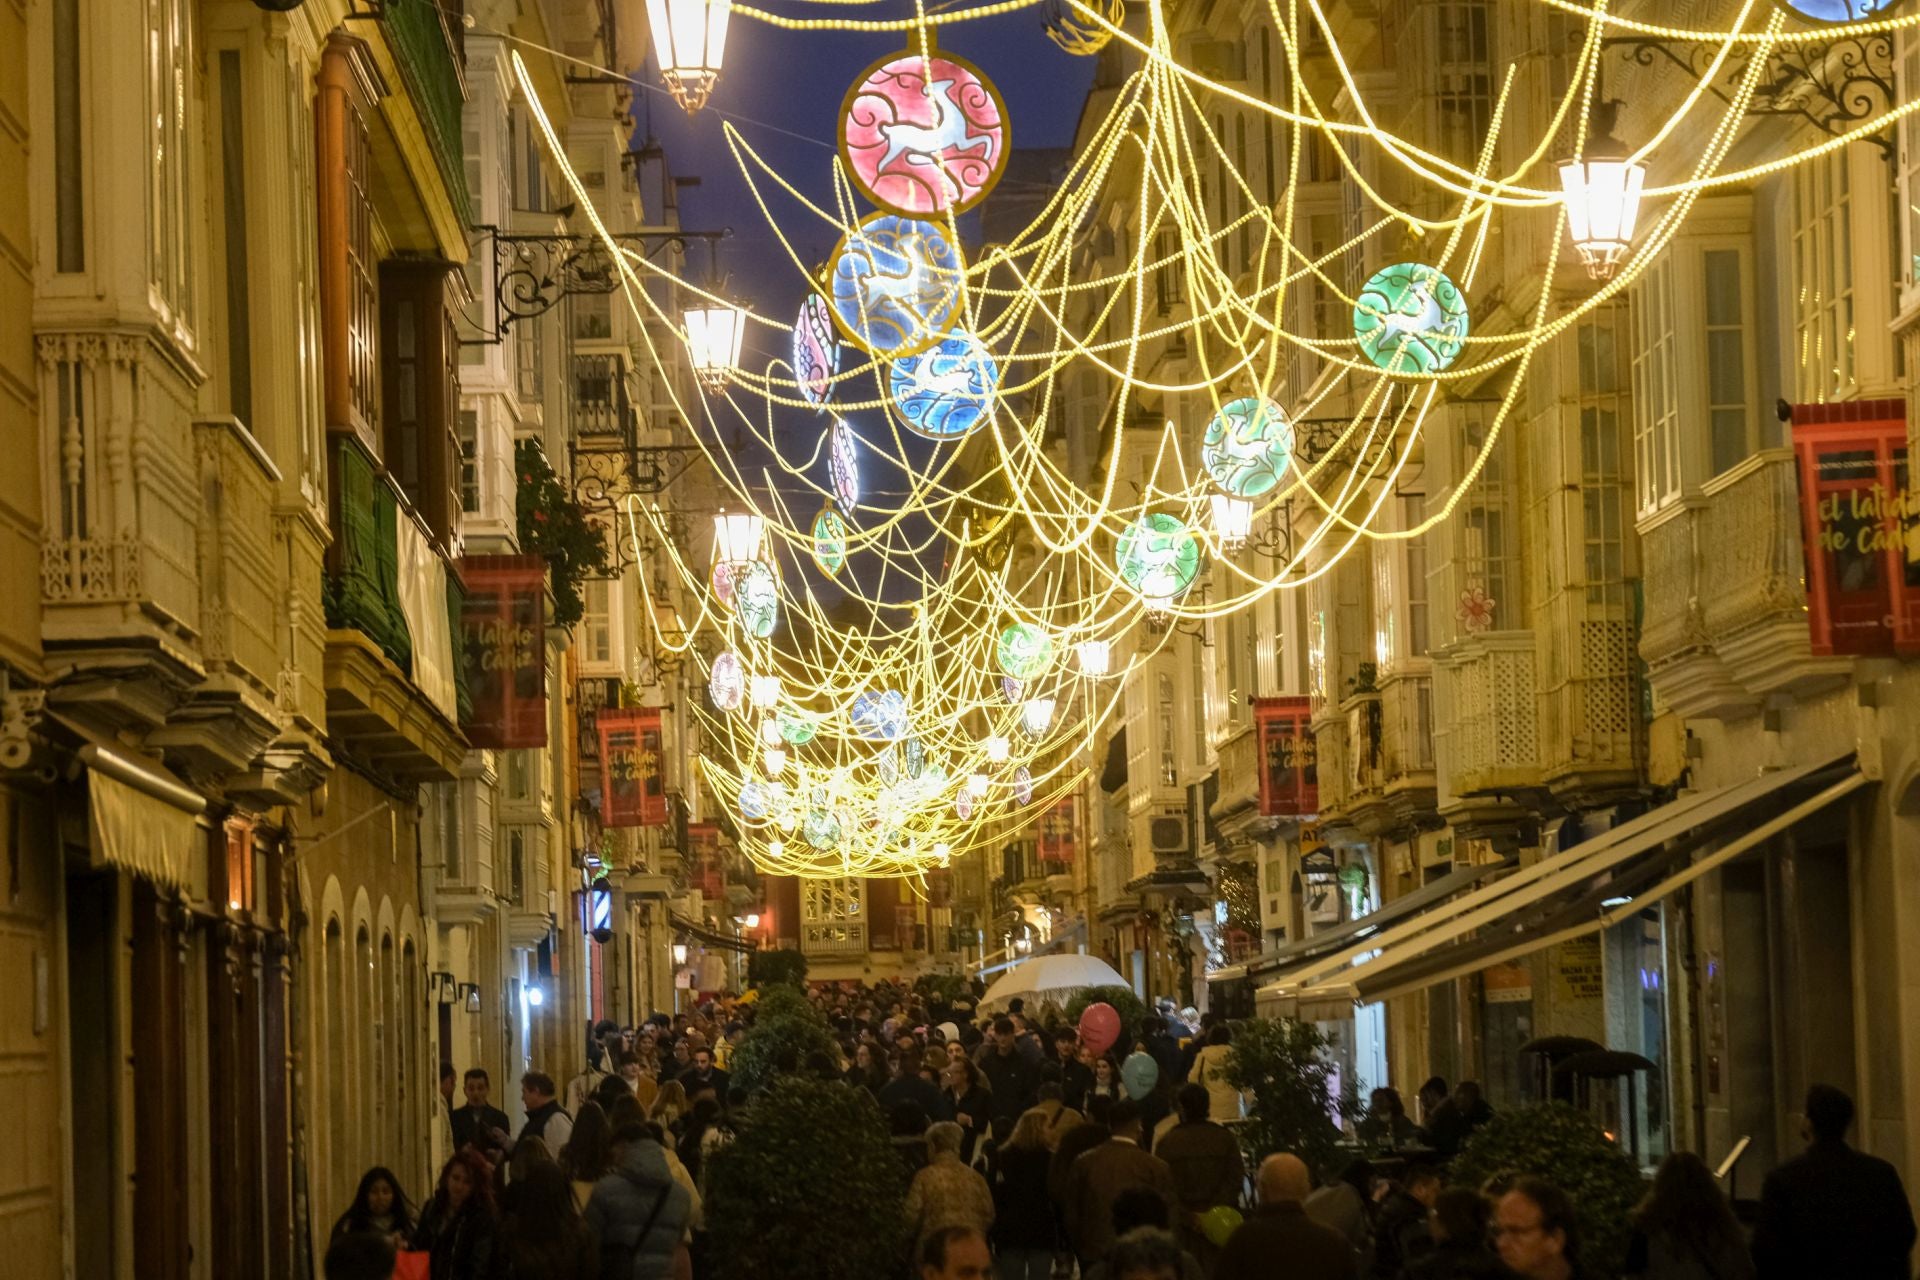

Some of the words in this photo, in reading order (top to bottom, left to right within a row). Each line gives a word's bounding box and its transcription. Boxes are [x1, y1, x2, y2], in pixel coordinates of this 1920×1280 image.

[1851, 482, 1913, 520] latid
[1818, 523, 1850, 553] de
[1857, 520, 1911, 554] Cádi
[479, 617, 533, 646] latido
